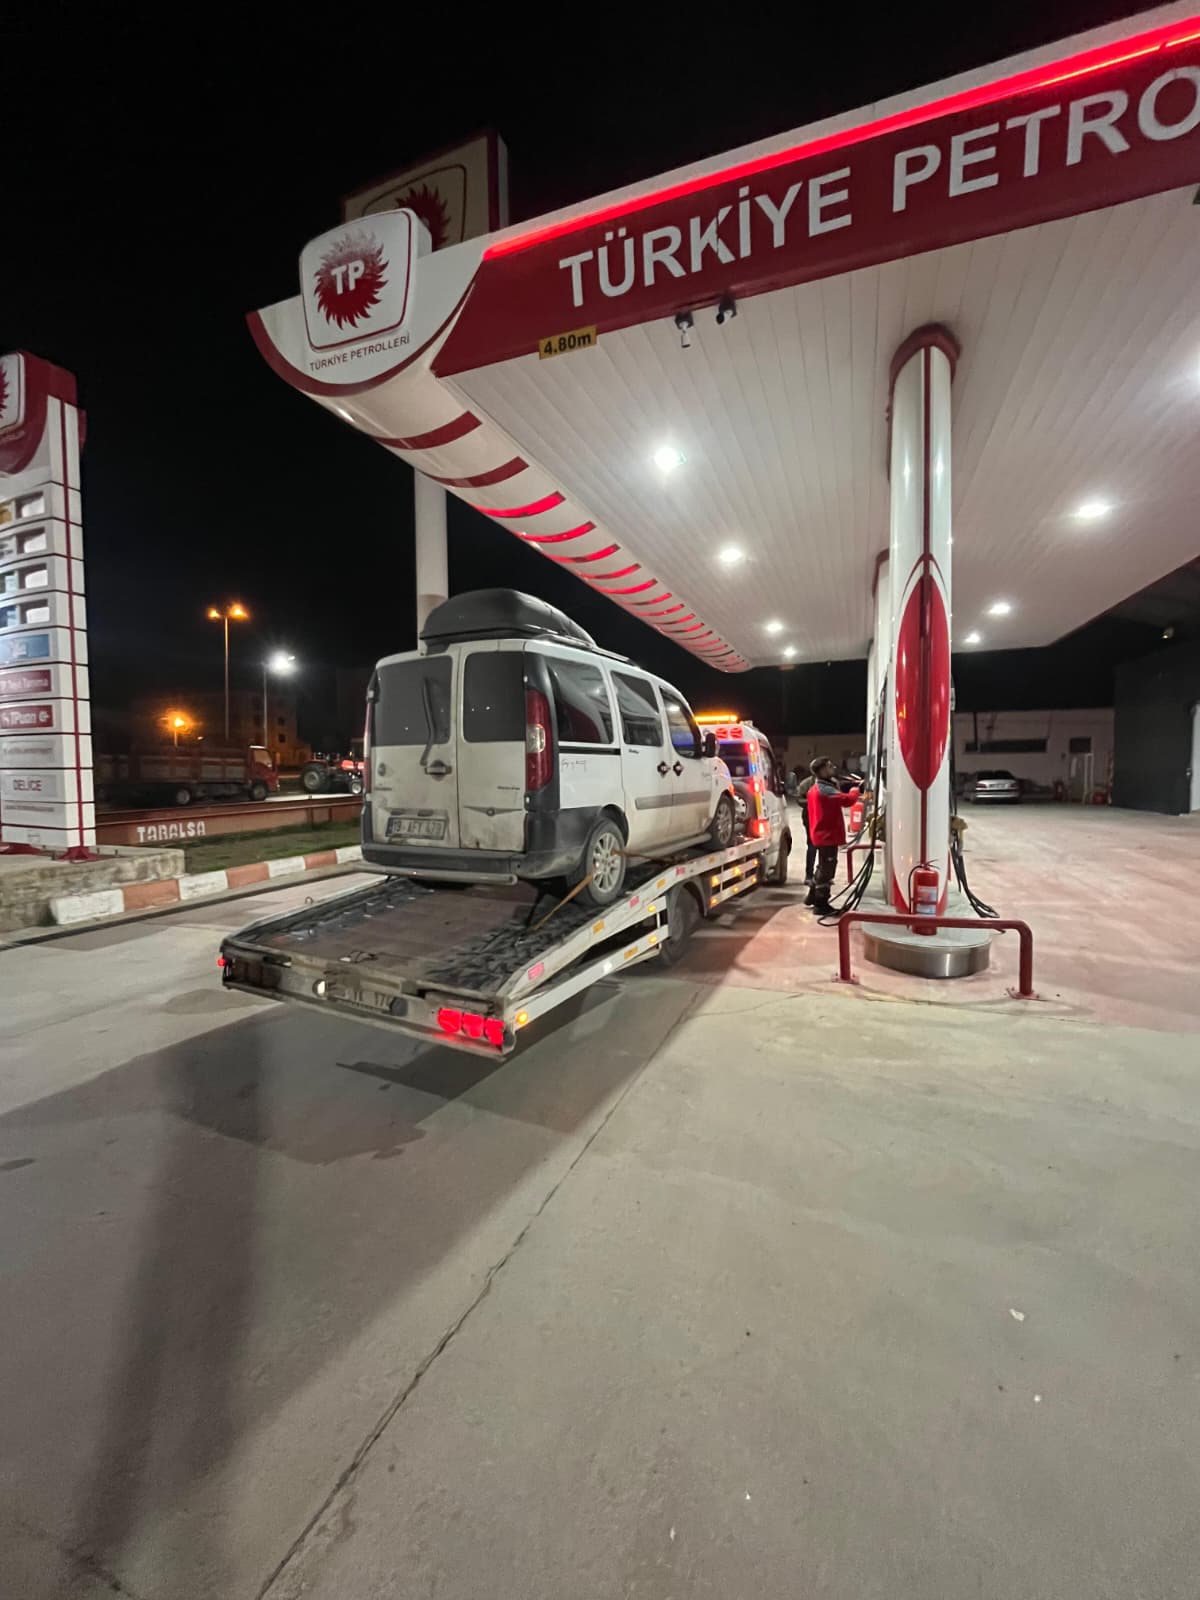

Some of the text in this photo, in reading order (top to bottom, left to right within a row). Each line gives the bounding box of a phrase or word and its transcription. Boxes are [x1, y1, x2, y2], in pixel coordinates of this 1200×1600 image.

[559, 65, 1200, 308] TÜRKİYE PETRO
[331, 260, 365, 295] TP
[309, 332, 410, 372] TÜRKİYE PETROLLERİ
[543, 333, 592, 355] 4.80m
[136, 821, 206, 843] TARALSA
